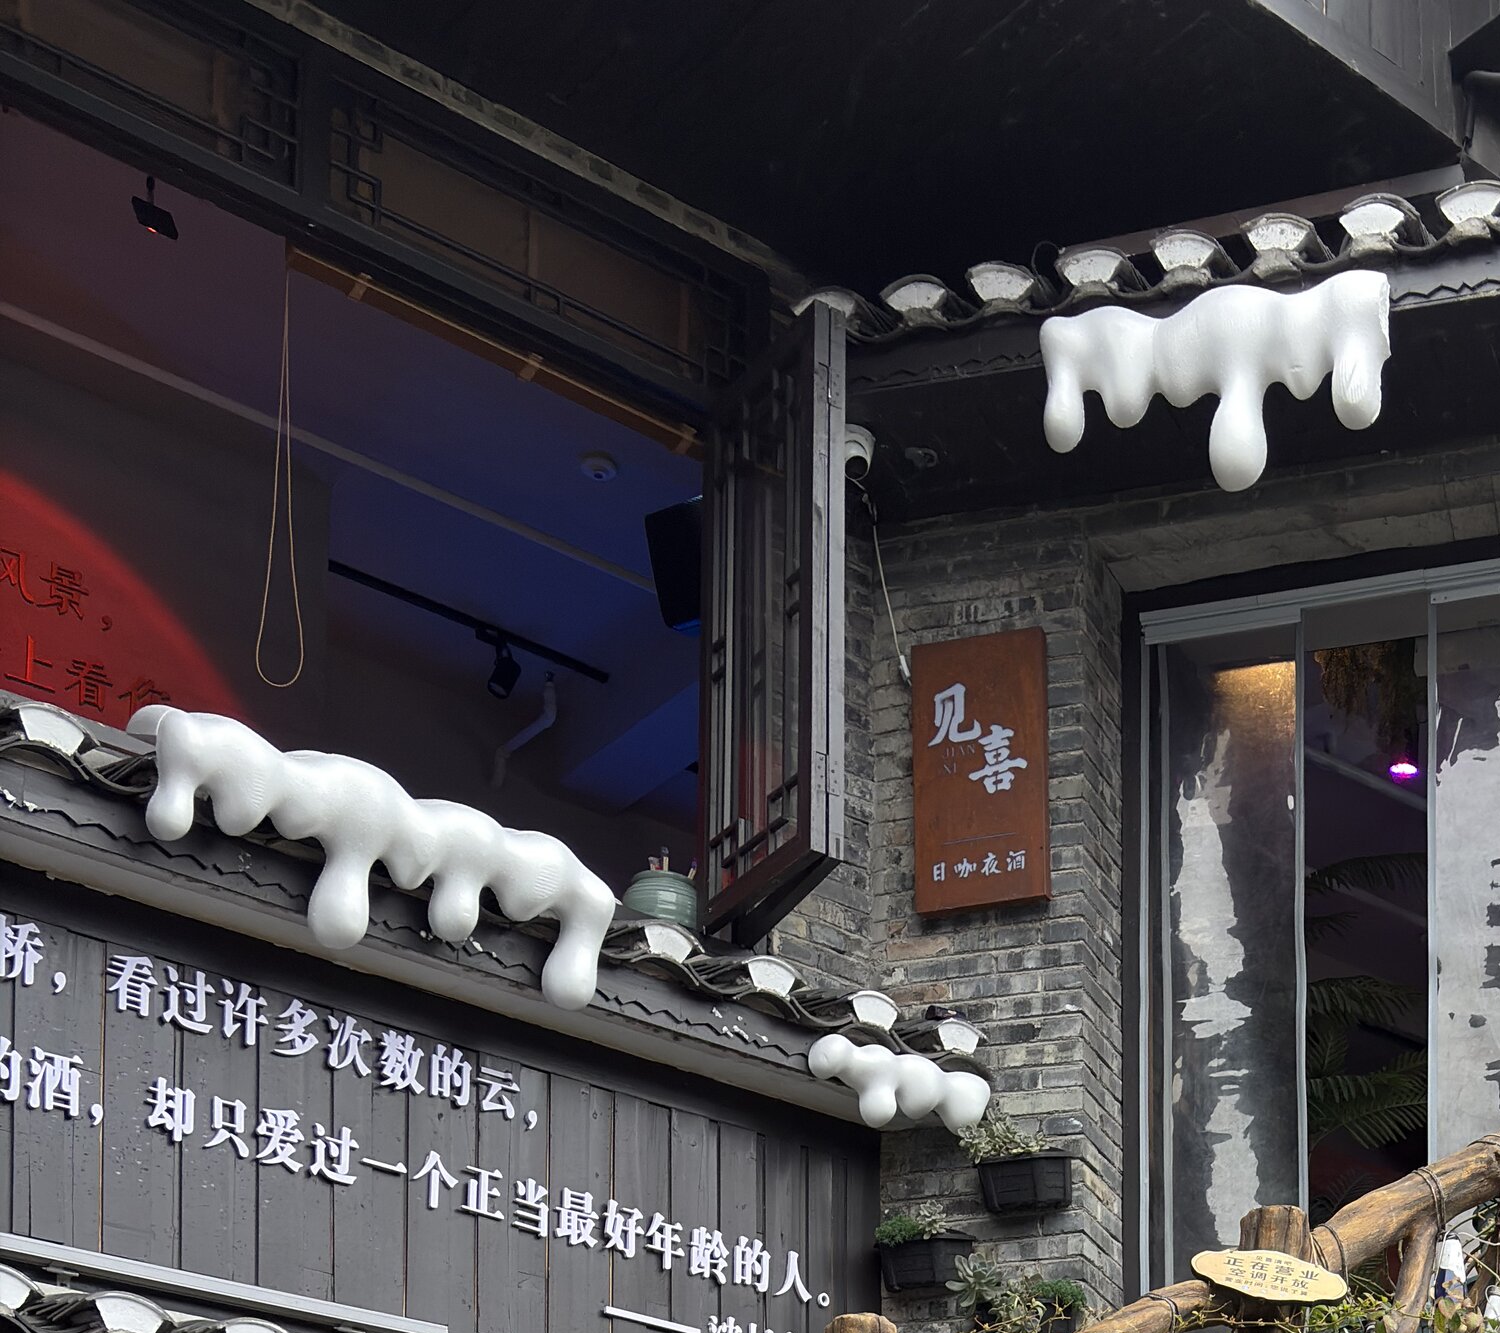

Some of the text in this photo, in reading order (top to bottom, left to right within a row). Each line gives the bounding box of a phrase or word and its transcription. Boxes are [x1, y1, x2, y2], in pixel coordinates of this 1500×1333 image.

[928, 683, 1028, 794] 见喜
[1224, 1256, 1319, 1281] 正在营业
[1230, 1267, 1308, 1290] 空调开放
